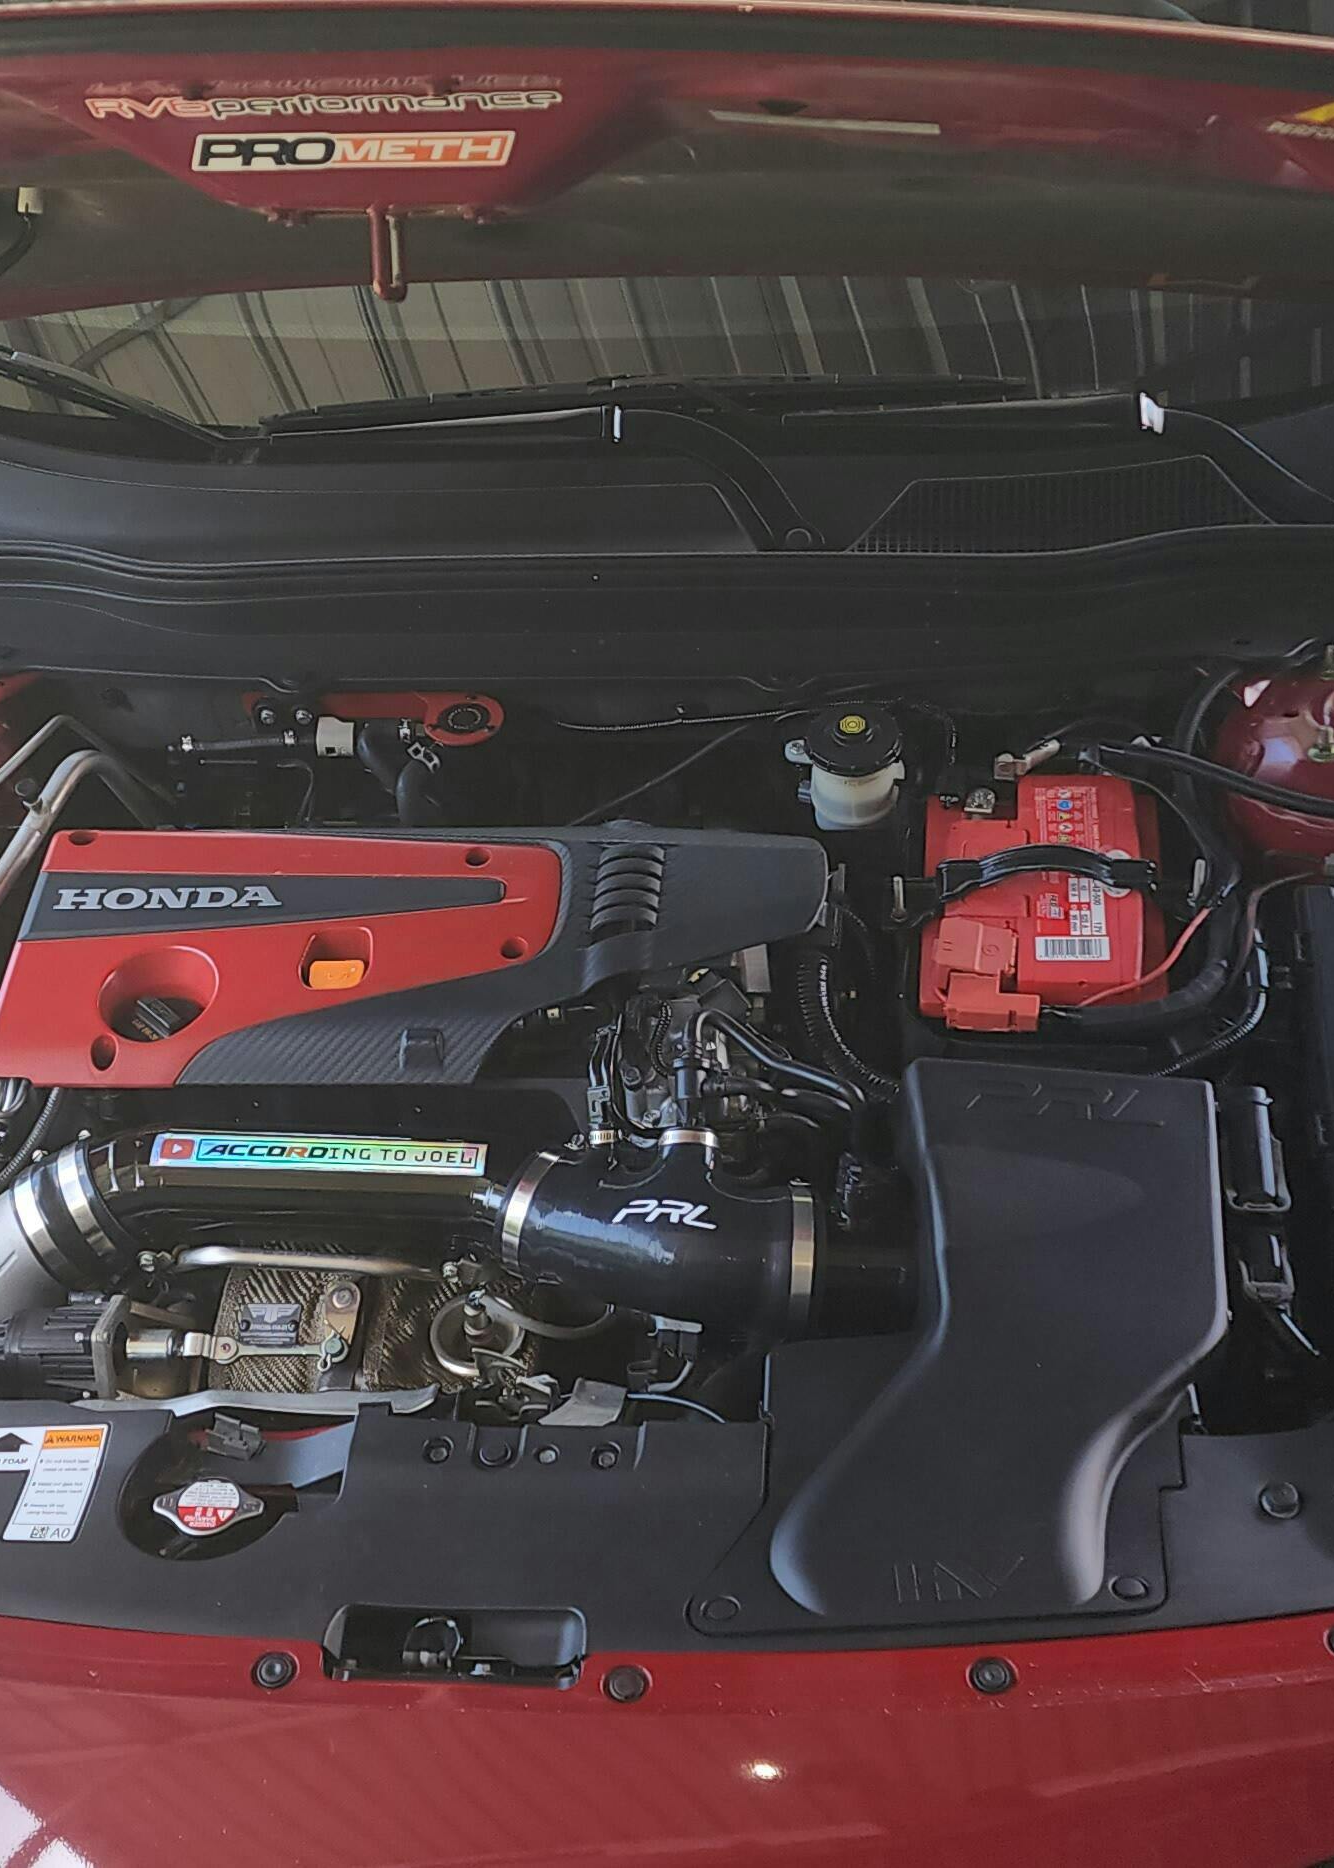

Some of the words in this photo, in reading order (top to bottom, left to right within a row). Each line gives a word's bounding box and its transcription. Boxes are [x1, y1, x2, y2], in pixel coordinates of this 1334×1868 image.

[197, 137, 506, 168] PROMETH
[53, 886, 282, 910] HONDA
[202, 1143, 371, 1160] ACCORDING
[380, 1148, 406, 1161] TO
[414, 1150, 475, 1165] JOEL
[612, 1199, 718, 1230] PRL
[55, 1433, 101, 1444] WARNING
